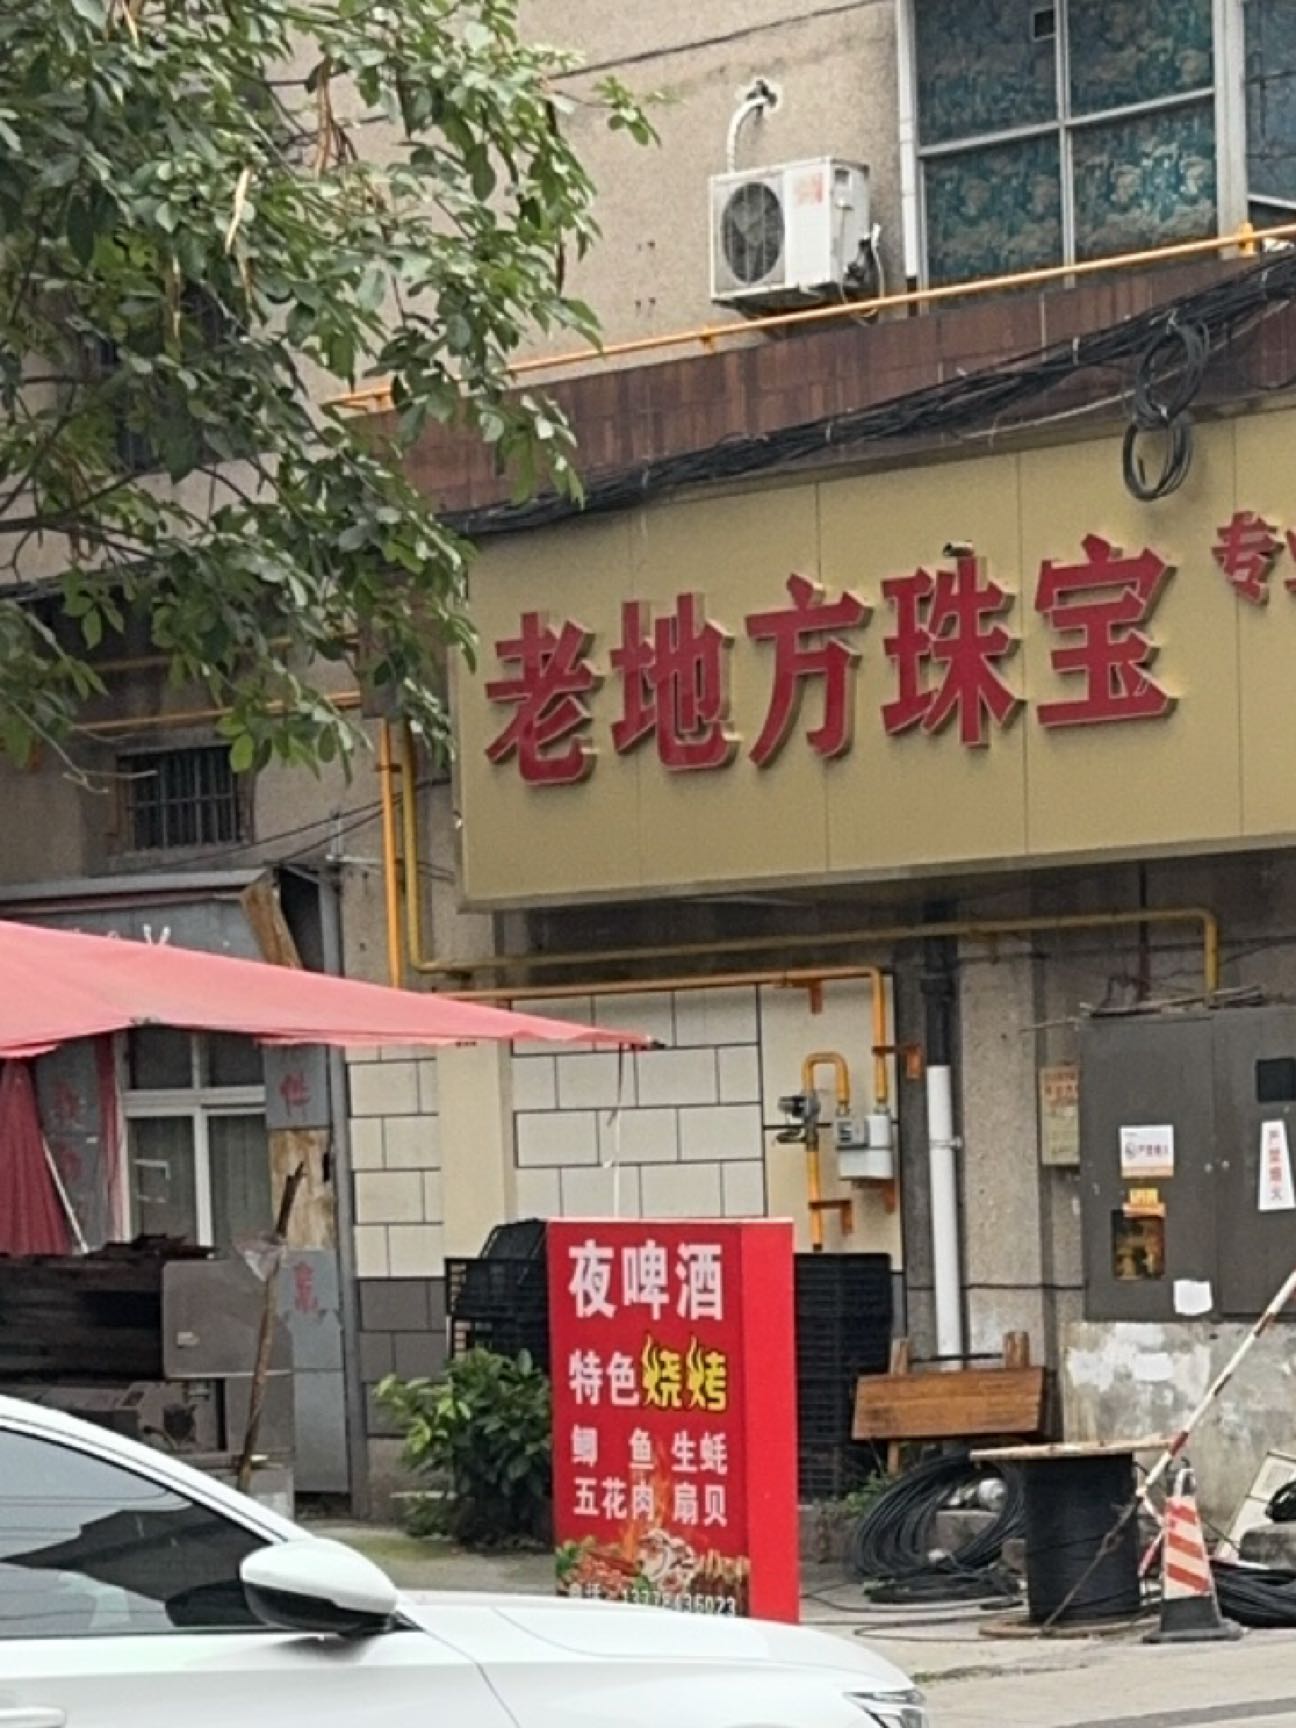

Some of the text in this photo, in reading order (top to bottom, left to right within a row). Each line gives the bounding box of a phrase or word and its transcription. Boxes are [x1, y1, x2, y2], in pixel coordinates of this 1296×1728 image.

[484, 533, 1179, 786] 老地方珠宝
[568, 1238, 724, 1321] 夜啤酒
[568, 1334, 728, 1412] 特色烧烤
[573, 1476, 728, 1527] 五花肉 扇贝
